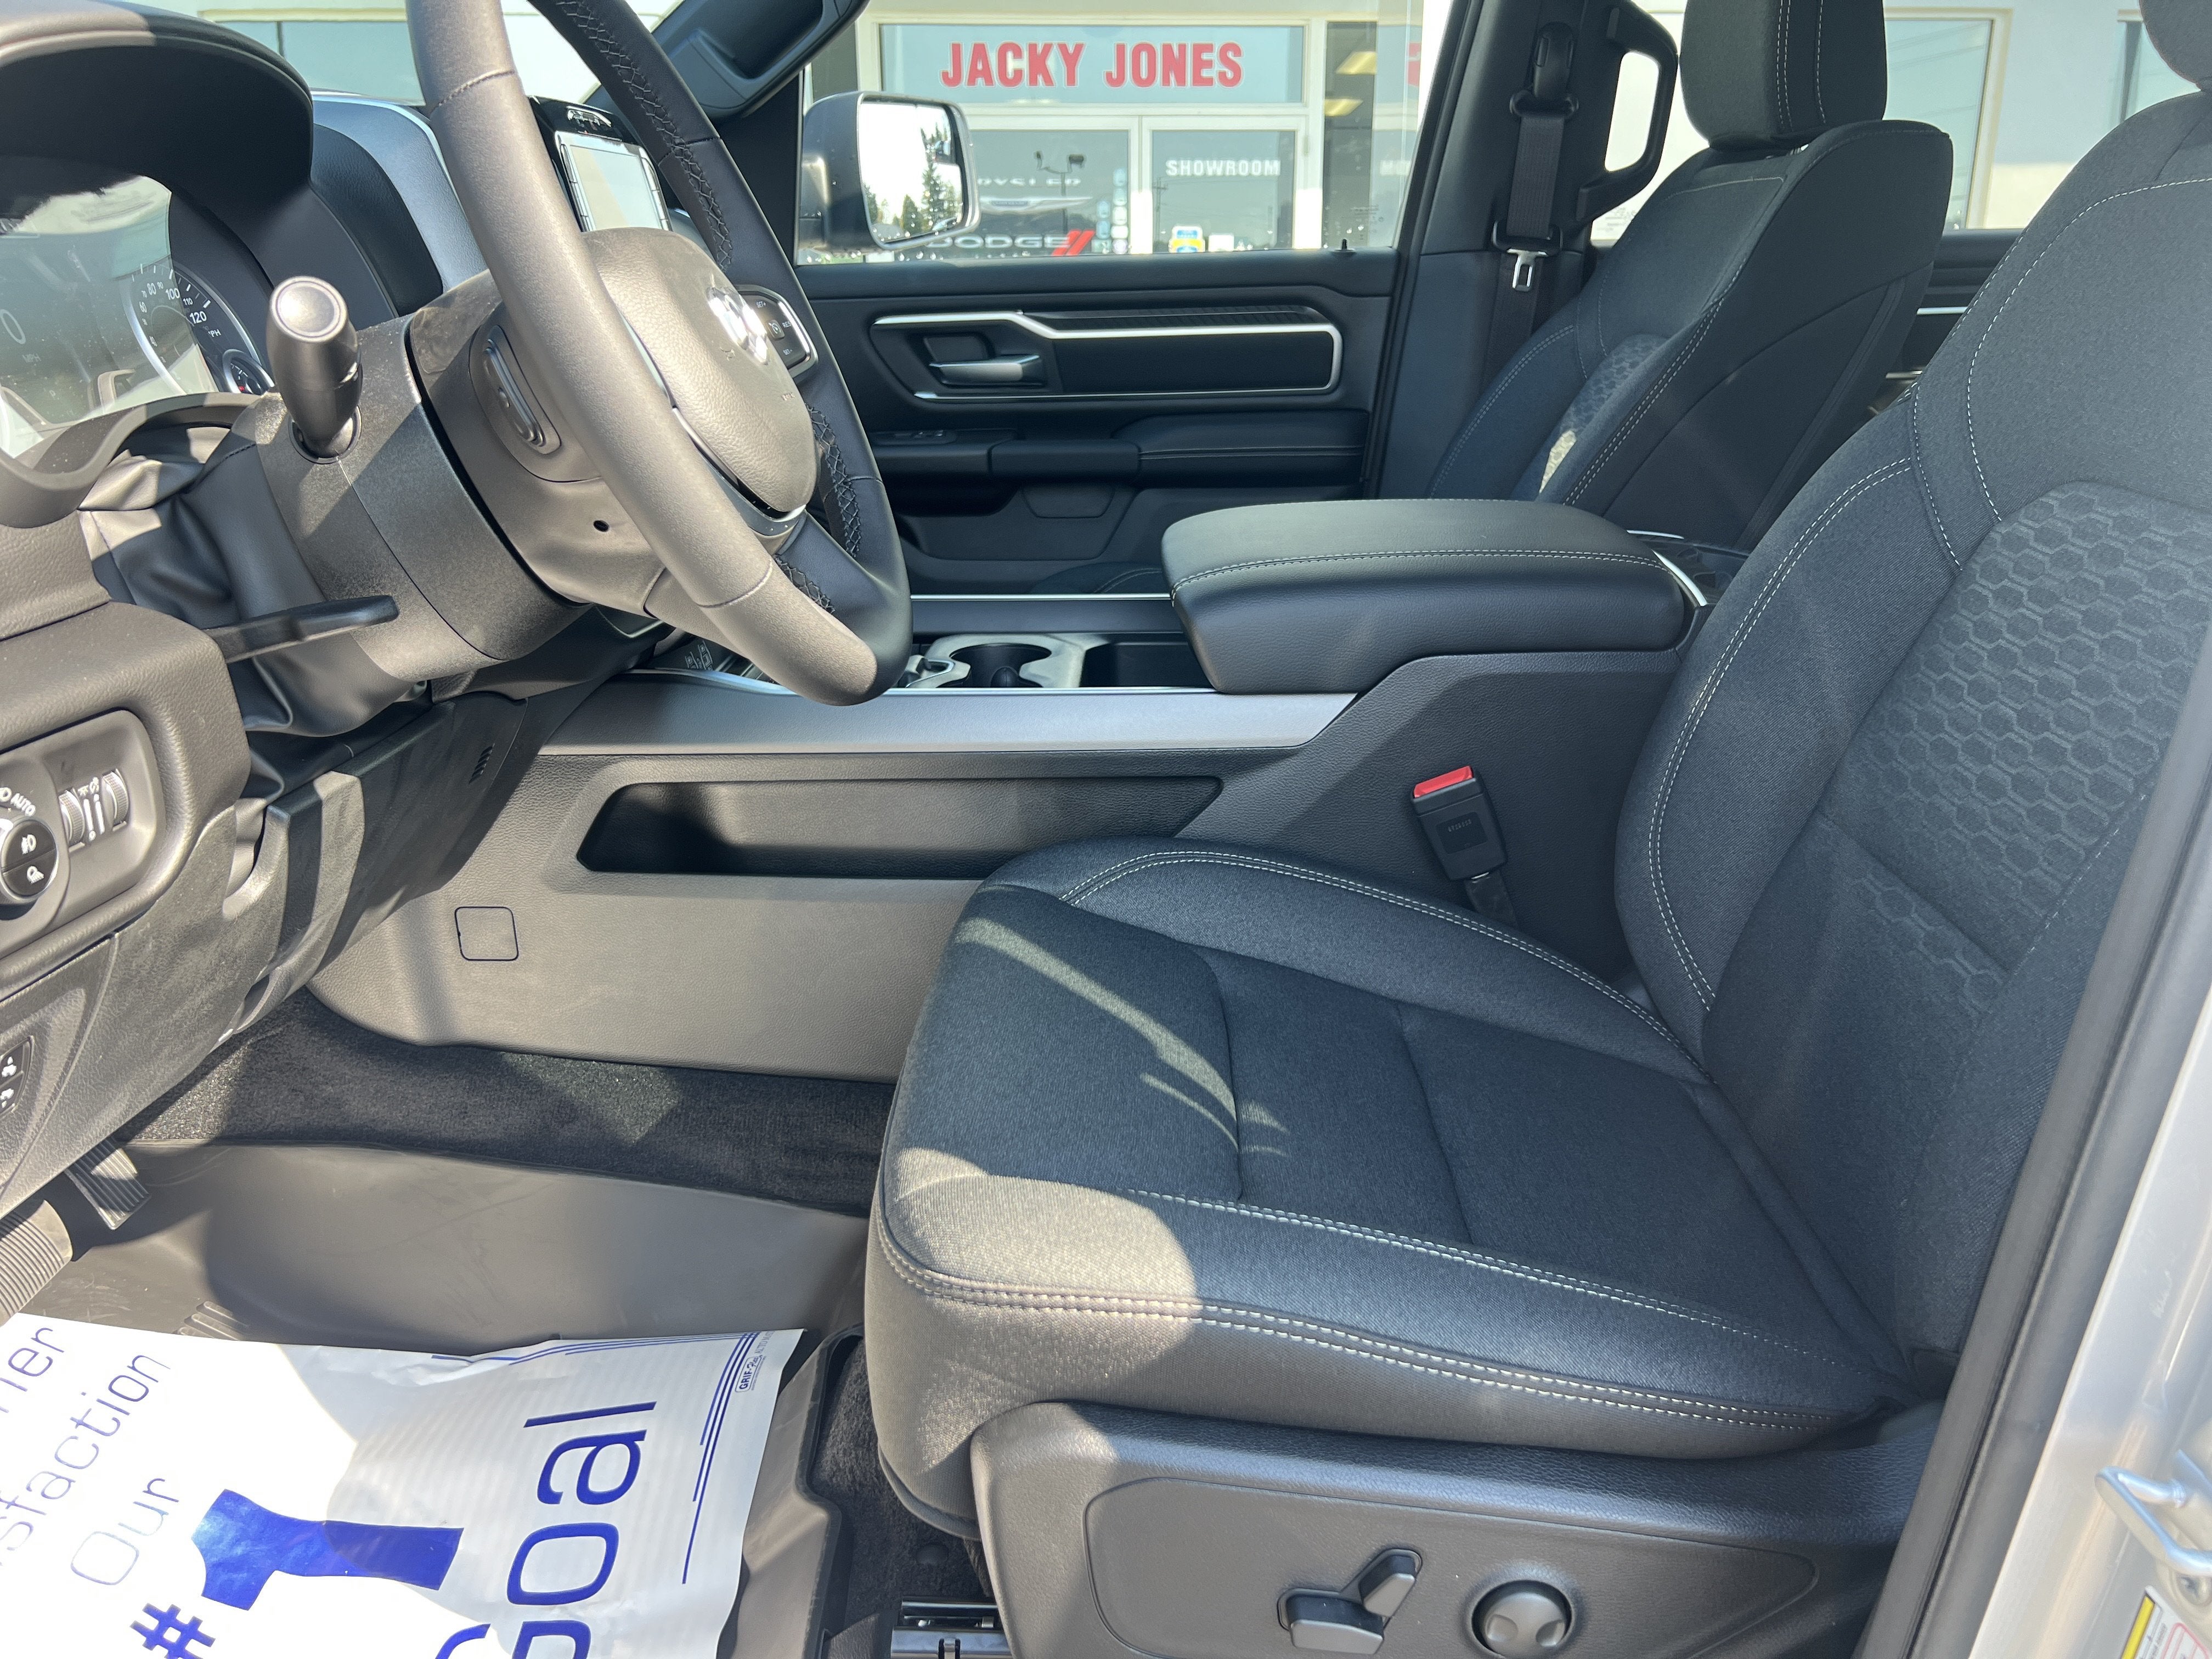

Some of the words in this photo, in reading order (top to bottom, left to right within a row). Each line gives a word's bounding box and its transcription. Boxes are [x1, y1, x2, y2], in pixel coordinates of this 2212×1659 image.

[940, 41, 1086, 88] JACKY
[1104, 41, 1244, 88] JONES
[1165, 159, 1281, 176] SHOWROOM
[147, 283, 156, 295] 80
[166, 287, 180, 300] 100
[183, 297, 193, 306] 110
[190, 311, 207, 324] 120
[10, 793, 36, 816] AUTO
[0, 1355, 171, 1566] sfaction
[71, 1477, 179, 1585] Our
